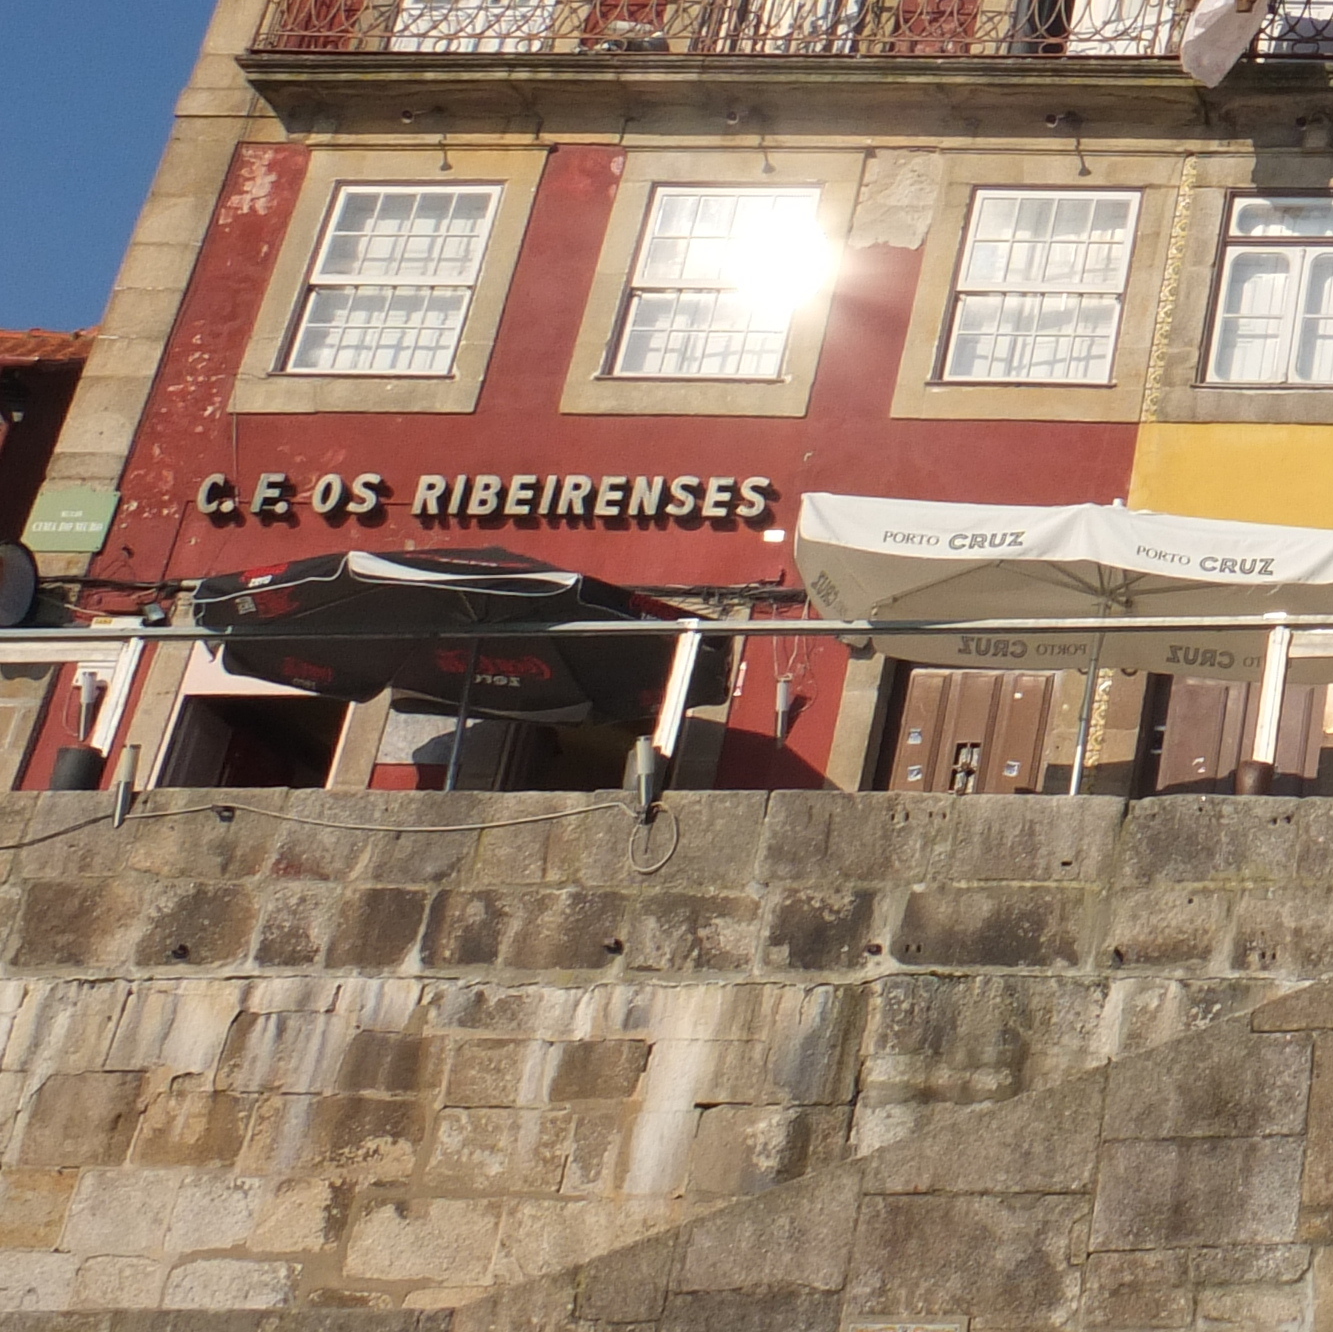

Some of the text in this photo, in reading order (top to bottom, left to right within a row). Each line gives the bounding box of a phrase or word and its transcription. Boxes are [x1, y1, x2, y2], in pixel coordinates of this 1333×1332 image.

[311, 472, 381, 514] OS
[410, 474, 771, 517] RIBEIRENSES
[883, 530, 1026, 550] PORTO CRUZ
[1136, 544, 1276, 576] PORTO CRUZ
